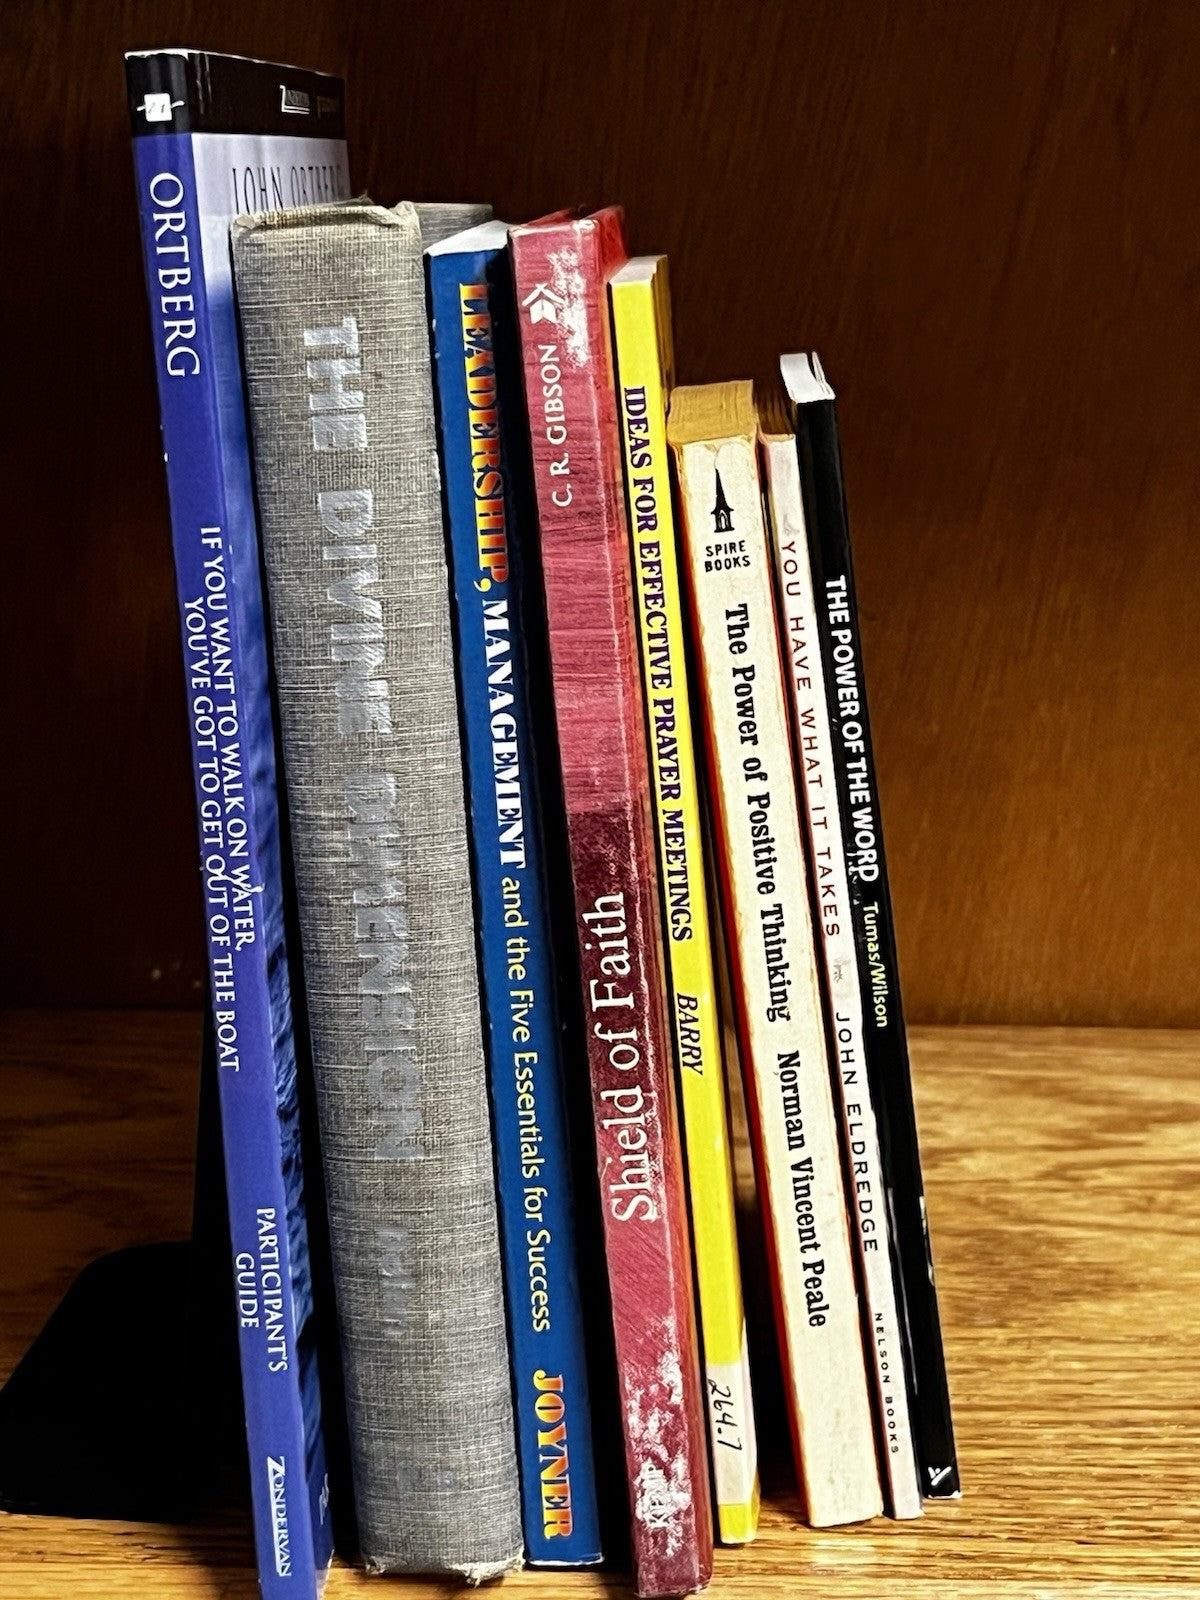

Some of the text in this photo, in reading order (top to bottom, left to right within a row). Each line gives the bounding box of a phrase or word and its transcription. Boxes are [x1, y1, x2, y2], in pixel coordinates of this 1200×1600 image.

[149, 172, 201, 377] ORTBERG
[304, 316, 368, 452] THE
[539, 343, 572, 507] C. R. GIBSON
[200, 526, 222, 549] IF
[203, 554, 228, 610] YOU
[318, 489, 393, 734] DIVINE
[704, 553, 751, 572] BOOKS
[705, 540, 747, 559] SPIRE
[210, 617, 235, 694] WANT
[217, 700, 239, 736] TO
[623, 385, 693, 942] IDEAS FOR EFFECTIVE PRAYER MEETINGS
[825, 575, 880, 882] THE POWER OF THE WORD
[220, 742, 245, 812] WALK
[459, 283, 551, 1332] LEADERSHIP, MANAGEMENT and the Five Essentials for Success
[725, 603, 792, 1023] The Power of Positive Thinking
[781, 542, 841, 937] YOU HAVE WHAT IT TAKES
[184, 597, 240, 1072] YOU'VE GOT TO GET OUT OF THE BOAT
[226, 818, 249, 856] ON
[677, 992, 704, 1076] BARRY
[863, 901, 888, 1028] Tumas/Wilson
[583, 892, 660, 1223] Shield of Faith
[835, 1011, 879, 1253] JOHN ELDREDGE
[777, 1051, 829, 1328] Norman Vincent Peale
[235, 1252, 260, 1329] GUIDE
[256, 1207, 288, 1373] PARTICIPANT'S
[532, 1369, 573, 1540] JOYNER
[875, 1312, 899, 1455] NELSON BOOKS
[267, 1456, 291, 1577] ZONDERVAN
